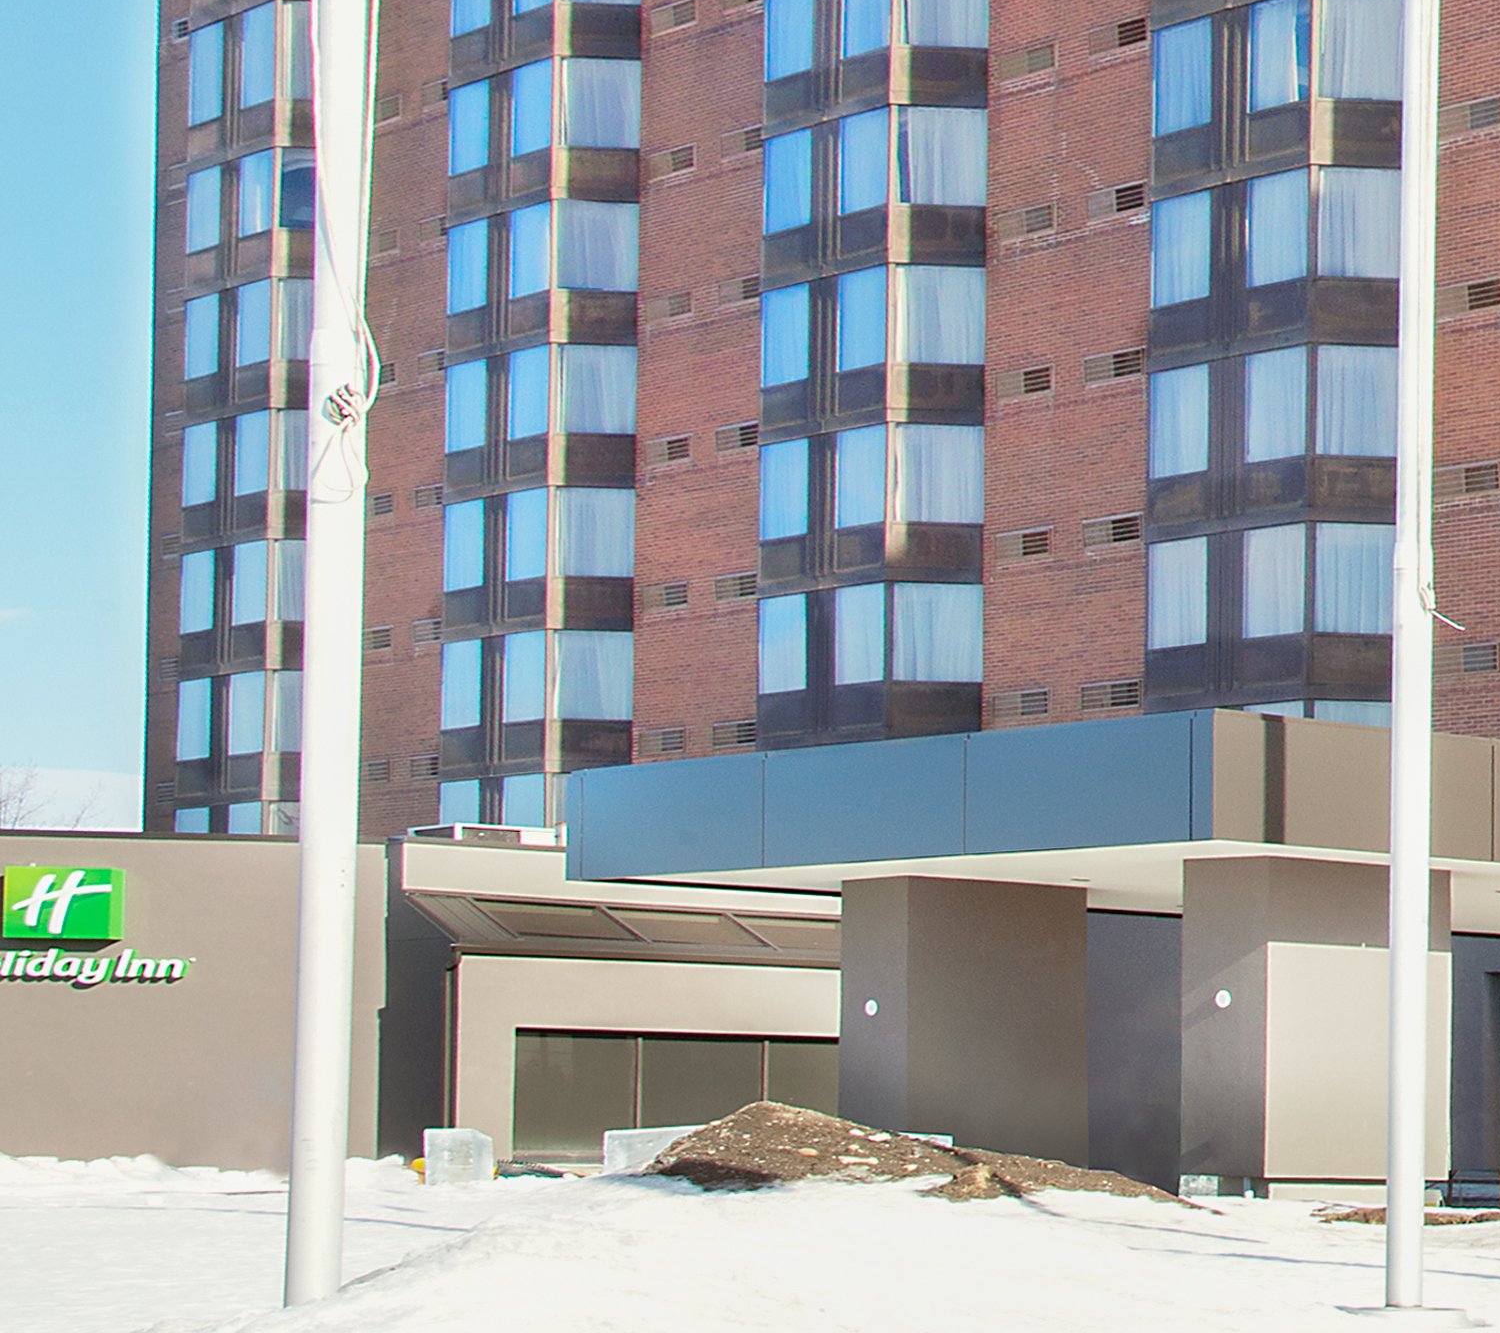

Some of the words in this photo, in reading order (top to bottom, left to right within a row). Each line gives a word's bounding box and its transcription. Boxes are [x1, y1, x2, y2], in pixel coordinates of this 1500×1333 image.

[11, 870, 112, 935] H
[0, 948, 110, 984] liday
[115, 949, 185, 979] Inn
